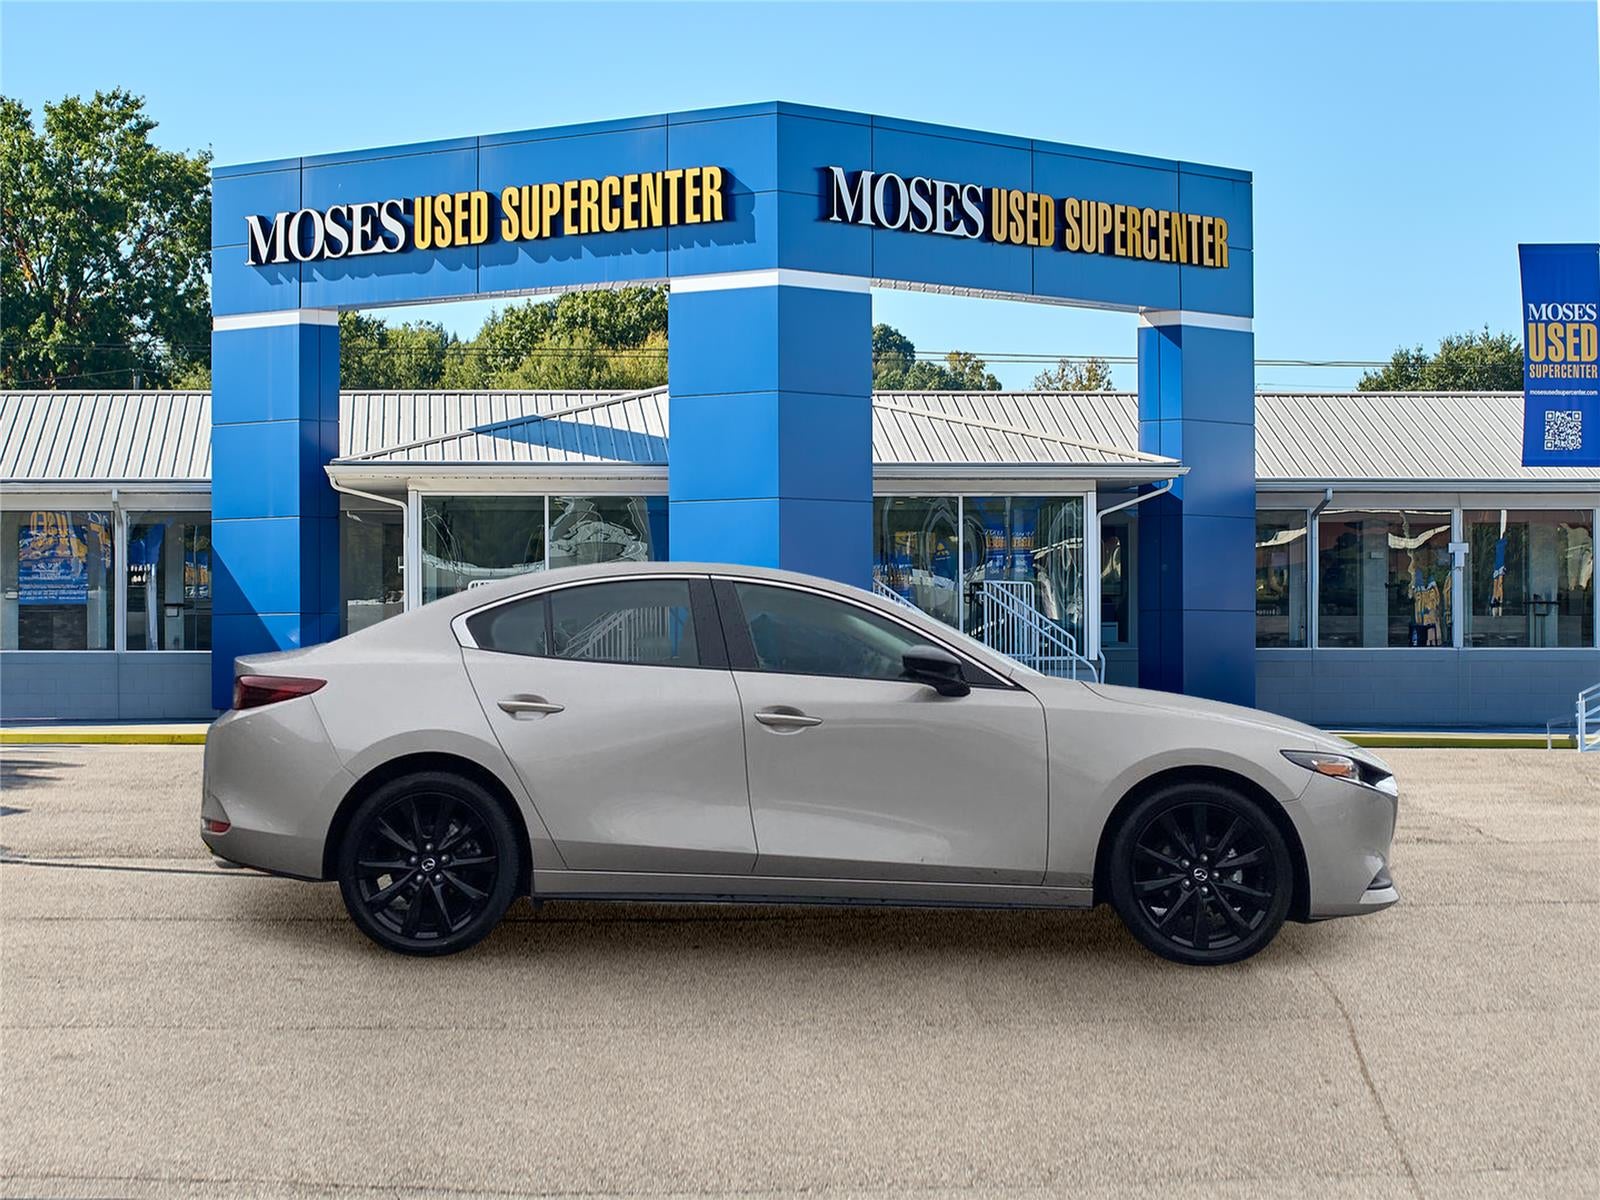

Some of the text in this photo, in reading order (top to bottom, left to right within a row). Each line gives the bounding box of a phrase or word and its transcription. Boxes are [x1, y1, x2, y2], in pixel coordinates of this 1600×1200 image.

[244, 166, 724, 267] MOSES USED SUPERCENTER
[828, 166, 1230, 269] MOSES USED SUPERCENTER
[1528, 303, 1598, 321] MOSES
[1529, 323, 1598, 362] USED
[1529, 364, 1598, 379] SUPERCENTER
